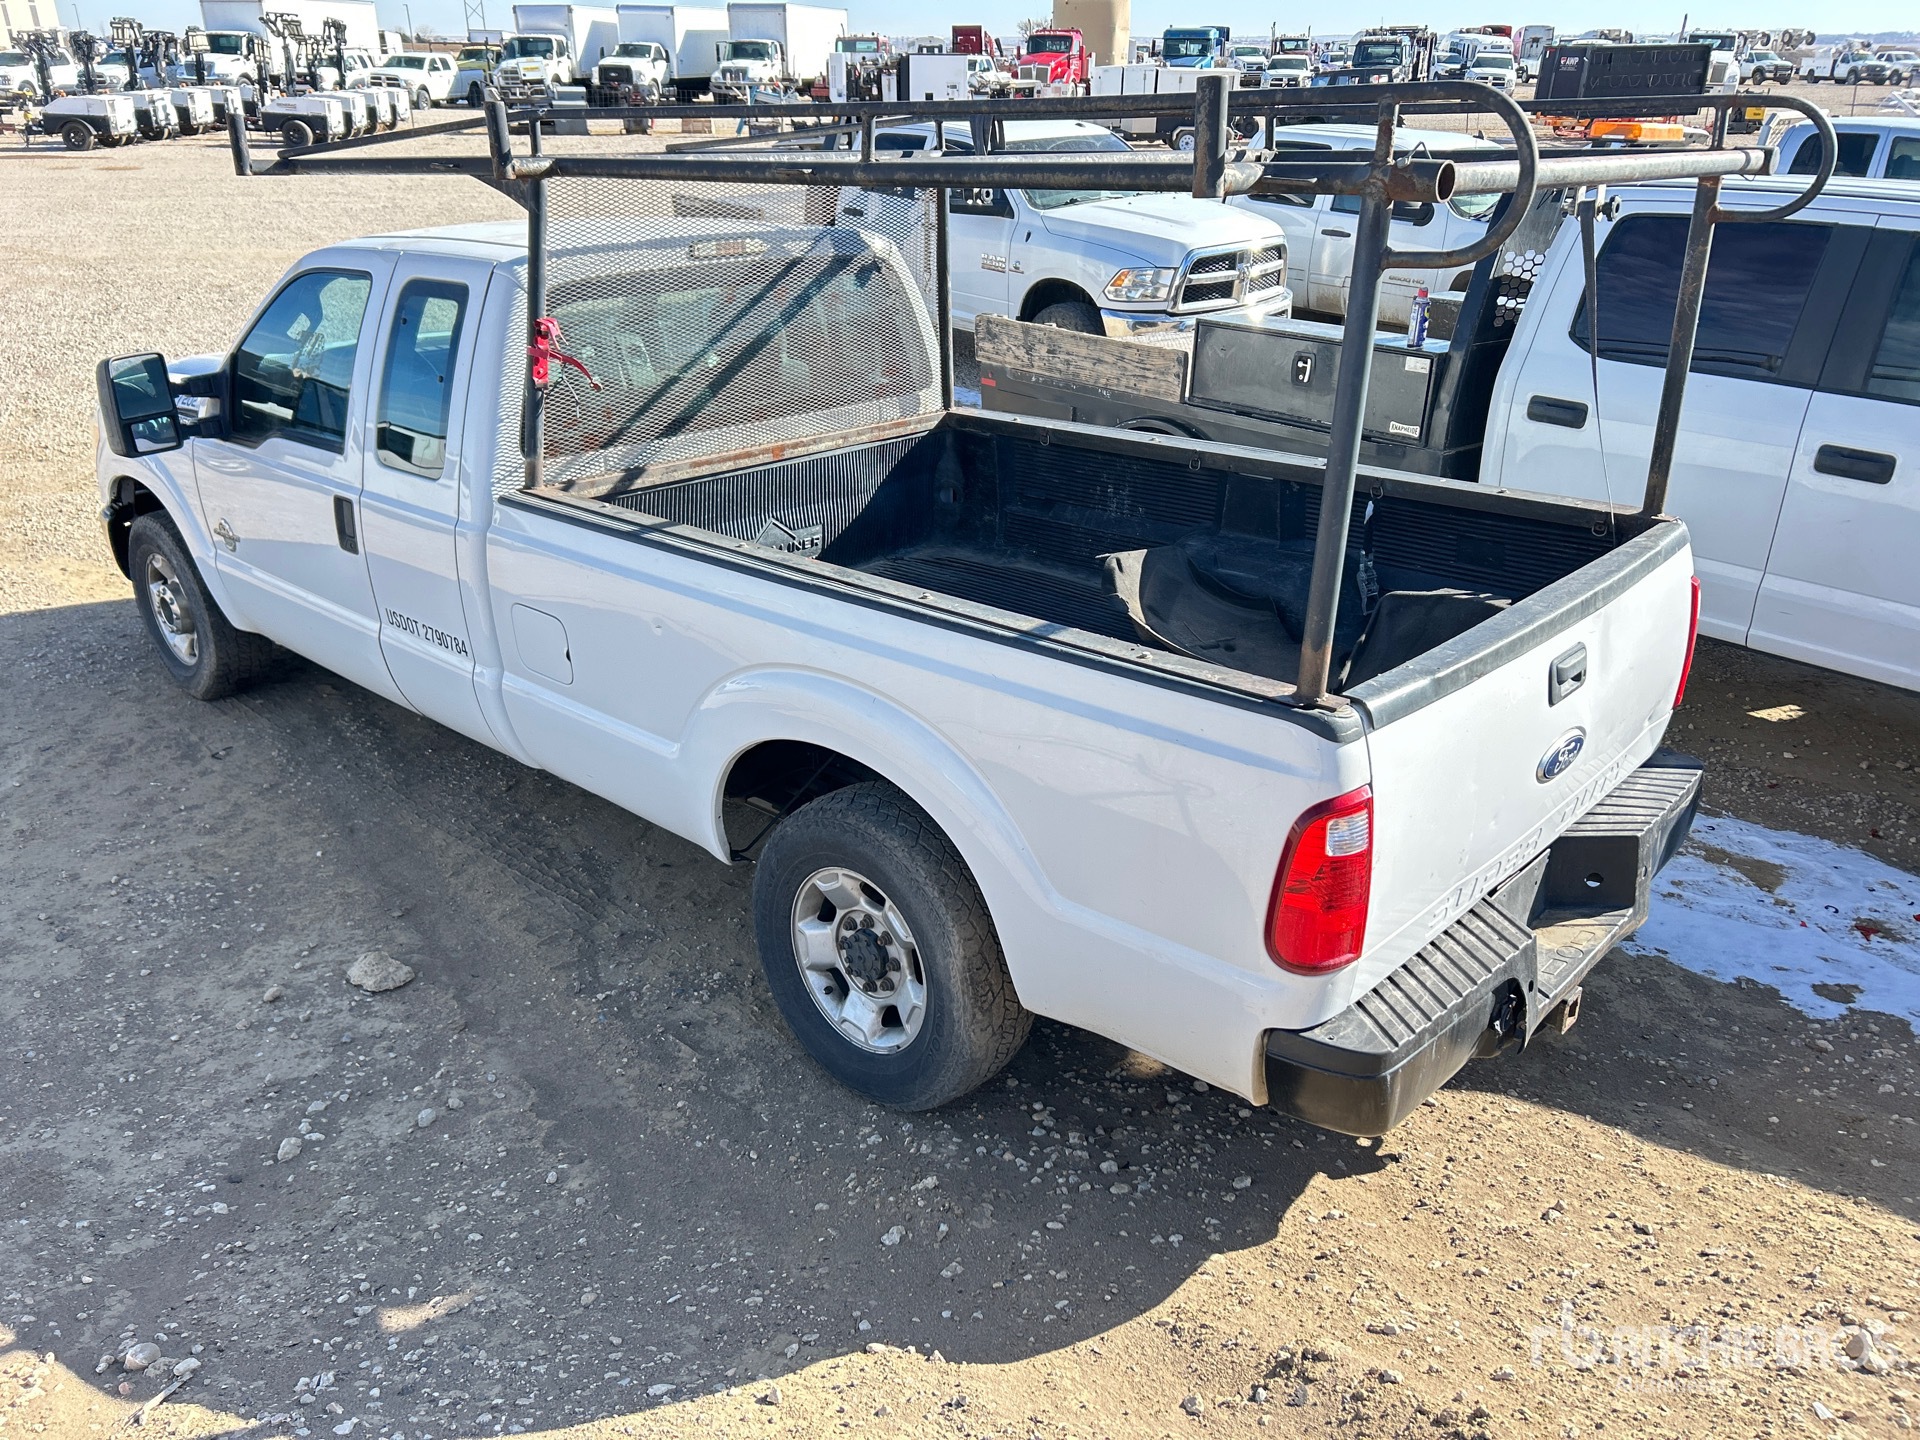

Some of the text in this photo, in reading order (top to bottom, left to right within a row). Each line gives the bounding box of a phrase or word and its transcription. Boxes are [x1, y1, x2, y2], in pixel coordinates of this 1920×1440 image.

[981, 253, 1006, 263] RAM
[1391, 423, 1419, 436] KNAPHEIDE
[385, 607, 468, 657] USDOT 2790784
[1428, 827, 1543, 926] SUPER
